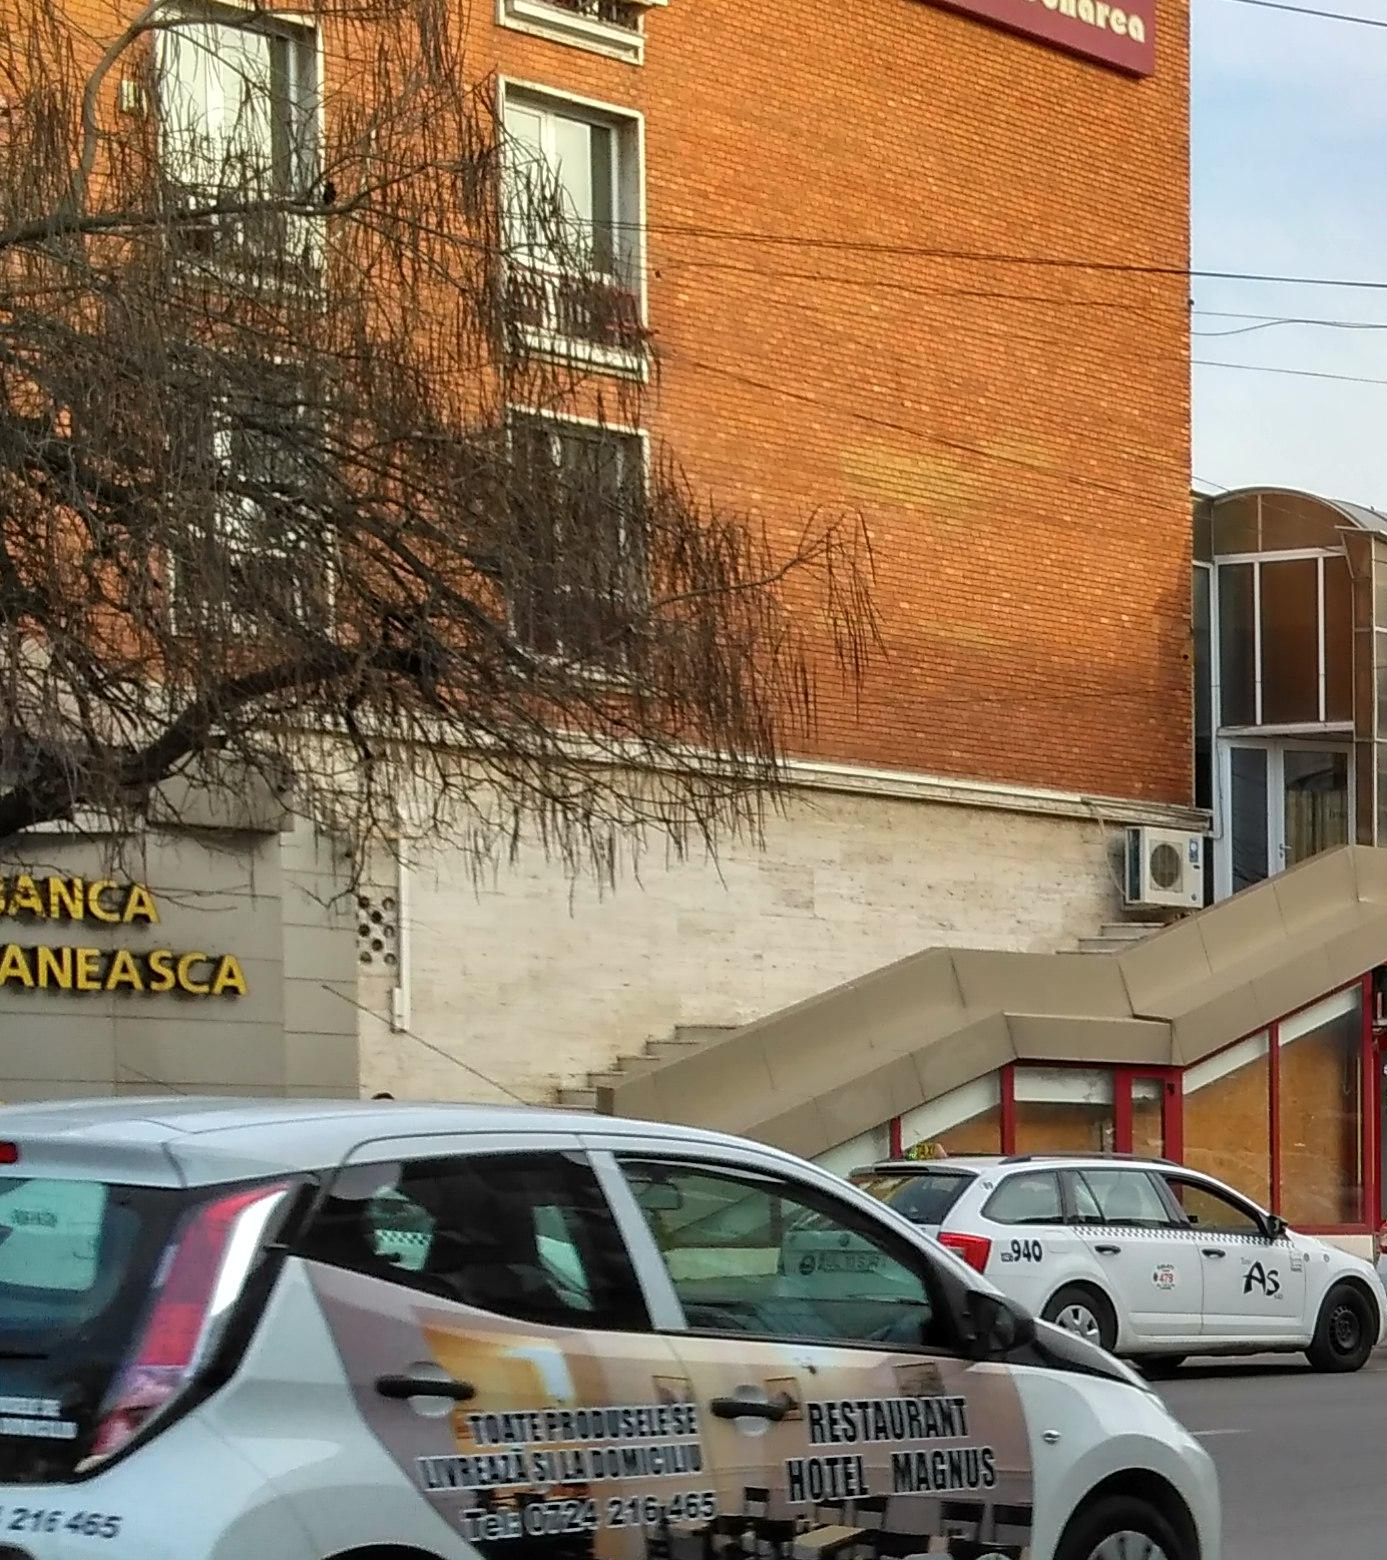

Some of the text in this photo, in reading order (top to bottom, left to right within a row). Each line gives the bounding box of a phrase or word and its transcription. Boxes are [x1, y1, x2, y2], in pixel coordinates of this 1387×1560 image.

[0, 874, 161, 924] ANCA
[1011, 1239, 1042, 1262] 940
[806, 1396, 970, 1446] RESTAURANT
[785, 1445, 998, 1504] HOTEL MAGNUS
[524, 1499, 599, 1537] 0724
